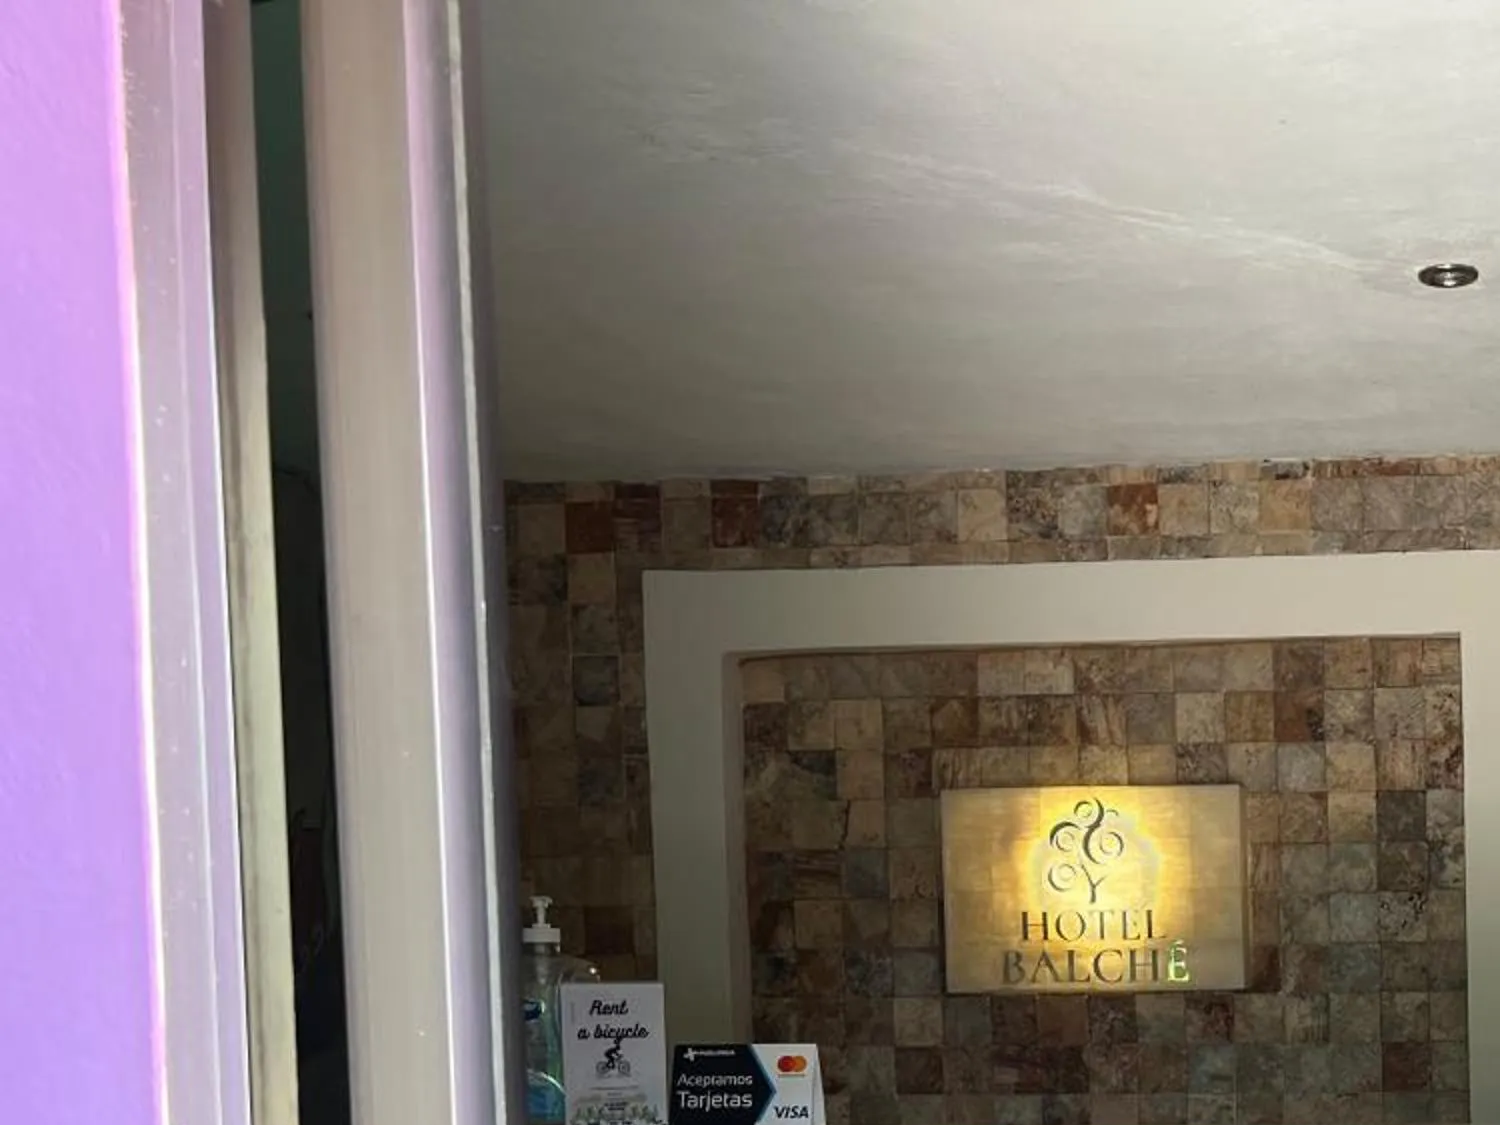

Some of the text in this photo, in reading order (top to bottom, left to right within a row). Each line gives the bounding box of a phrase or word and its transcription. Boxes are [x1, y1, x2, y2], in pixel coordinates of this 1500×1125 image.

[1021, 909, 1167, 941] HOTEL
[1003, 940, 1190, 984] BALCHÉ
[589, 1000, 629, 1016] Rent
[577, 1022, 649, 1043] a bicycle
[677, 1072, 753, 1088] Aceptamos
[677, 1091, 753, 1112] Tarjetas
[774, 1105, 809, 1119] VISA
